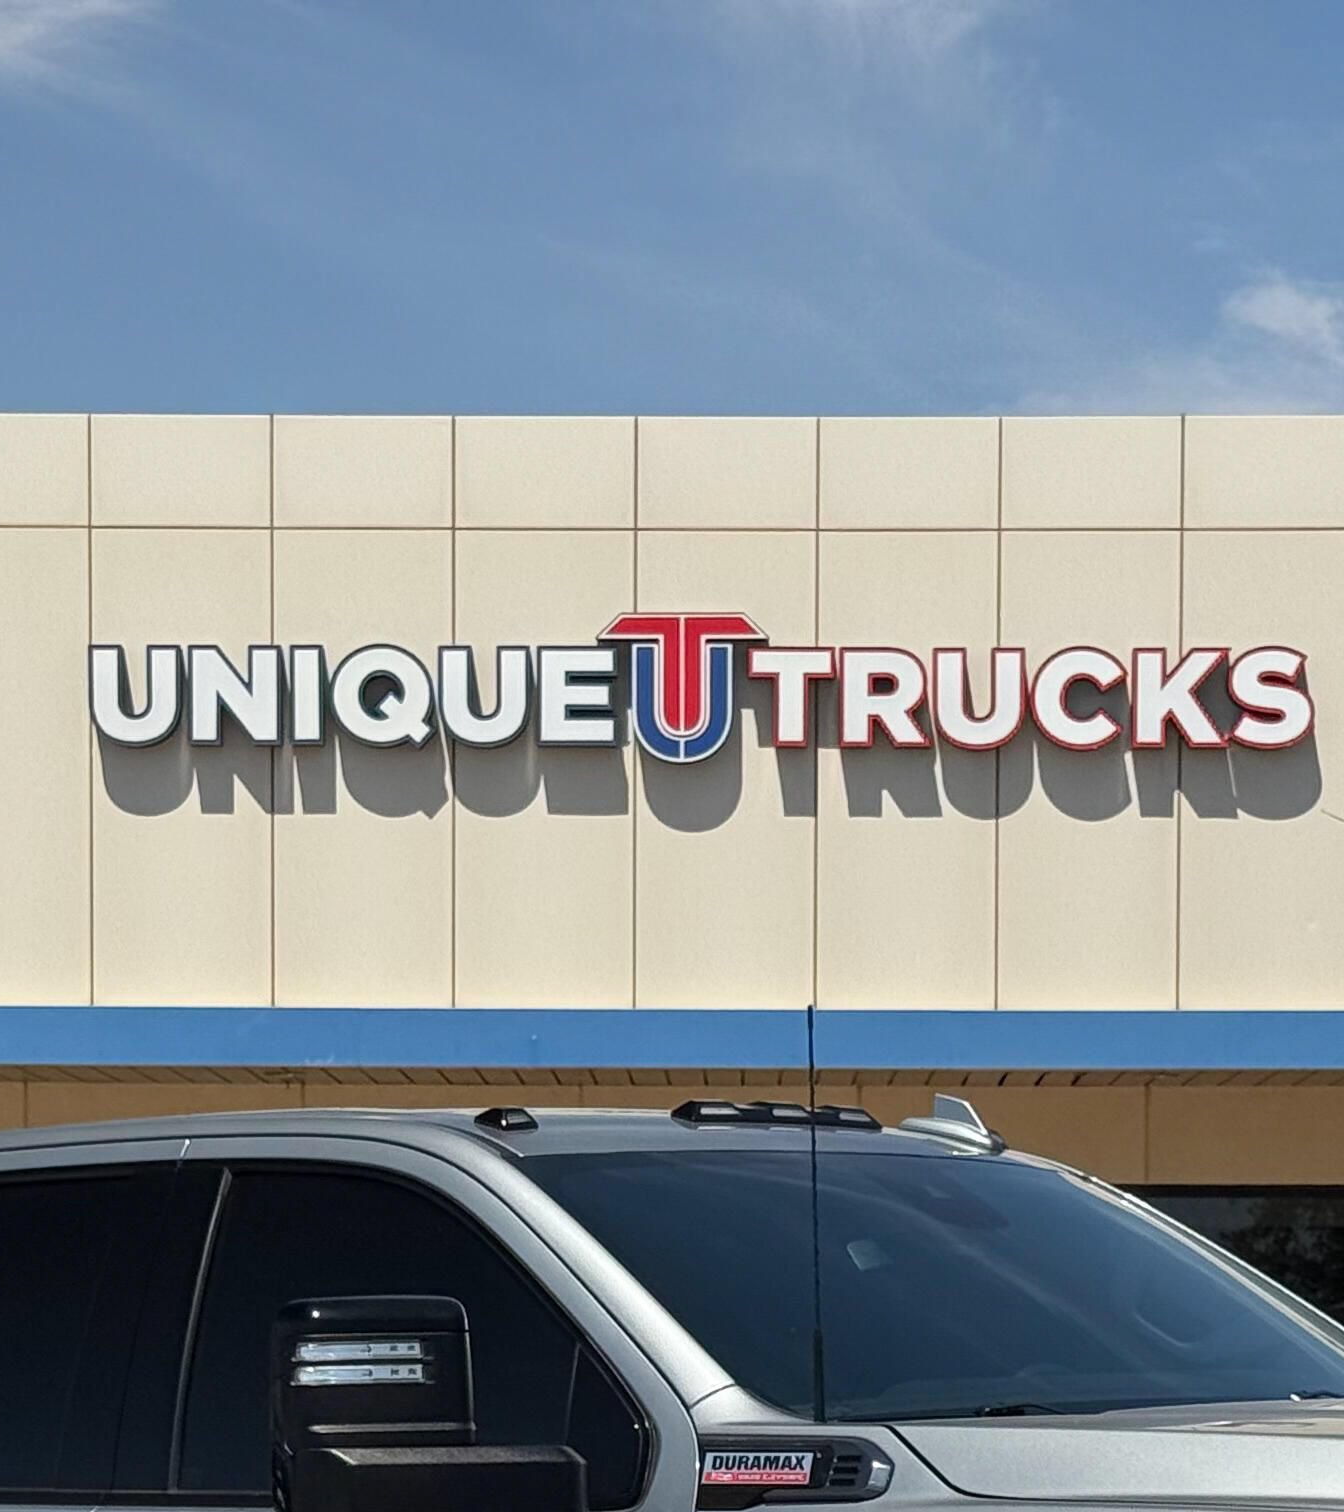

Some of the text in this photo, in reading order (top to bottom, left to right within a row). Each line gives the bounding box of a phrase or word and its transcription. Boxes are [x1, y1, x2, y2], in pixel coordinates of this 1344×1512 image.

[89, 645, 621, 748] UNIQUE
[748, 646, 1316, 750] TRUCKS
[711, 1455, 806, 1471] DURAMAX
